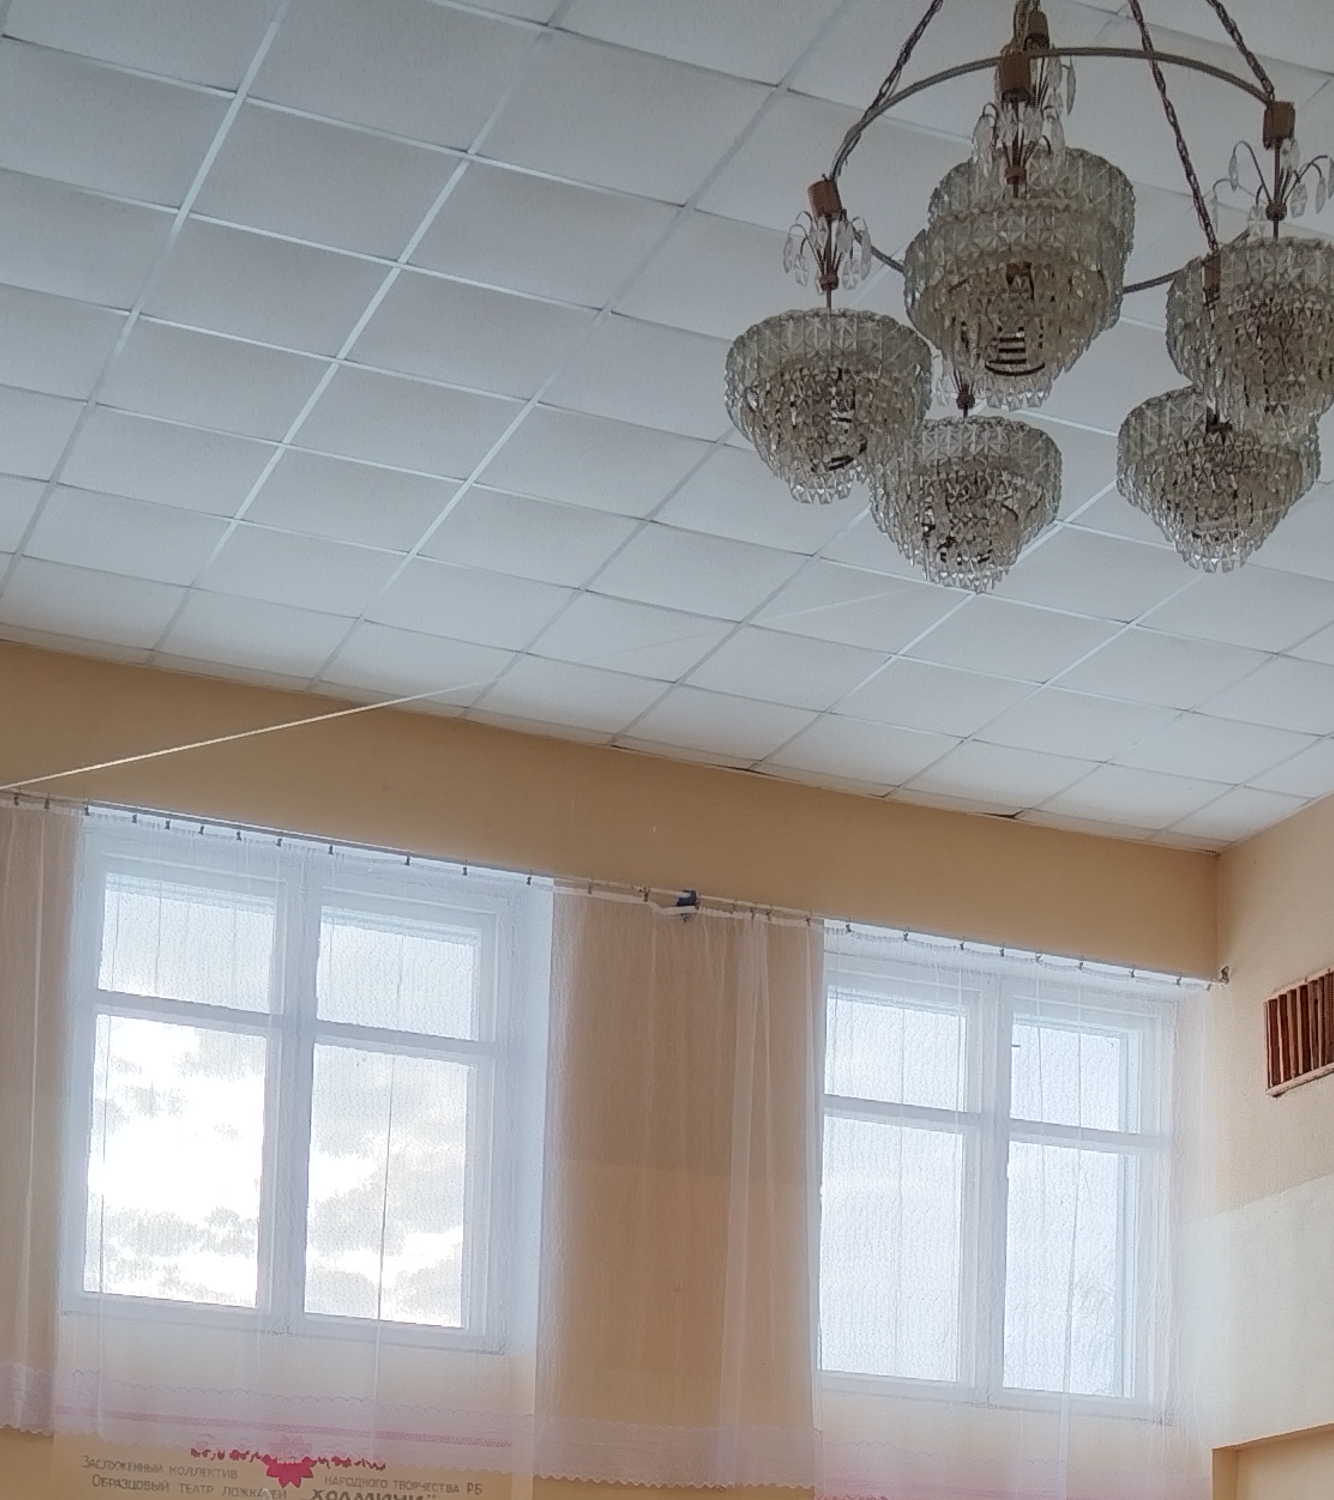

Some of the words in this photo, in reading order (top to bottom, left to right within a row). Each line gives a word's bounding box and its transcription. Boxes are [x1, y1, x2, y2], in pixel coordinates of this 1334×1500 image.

[169, 1464, 238, 1480] КОЛЛЕКТИВ
[324, 1475, 388, 1490] НАРОДНОГО
[393, 1479, 460, 1494] ТВОРЧЕСТВА
[467, 1482, 483, 1496] РБ
[179, 1483, 214, 1496] ТЕАТР
